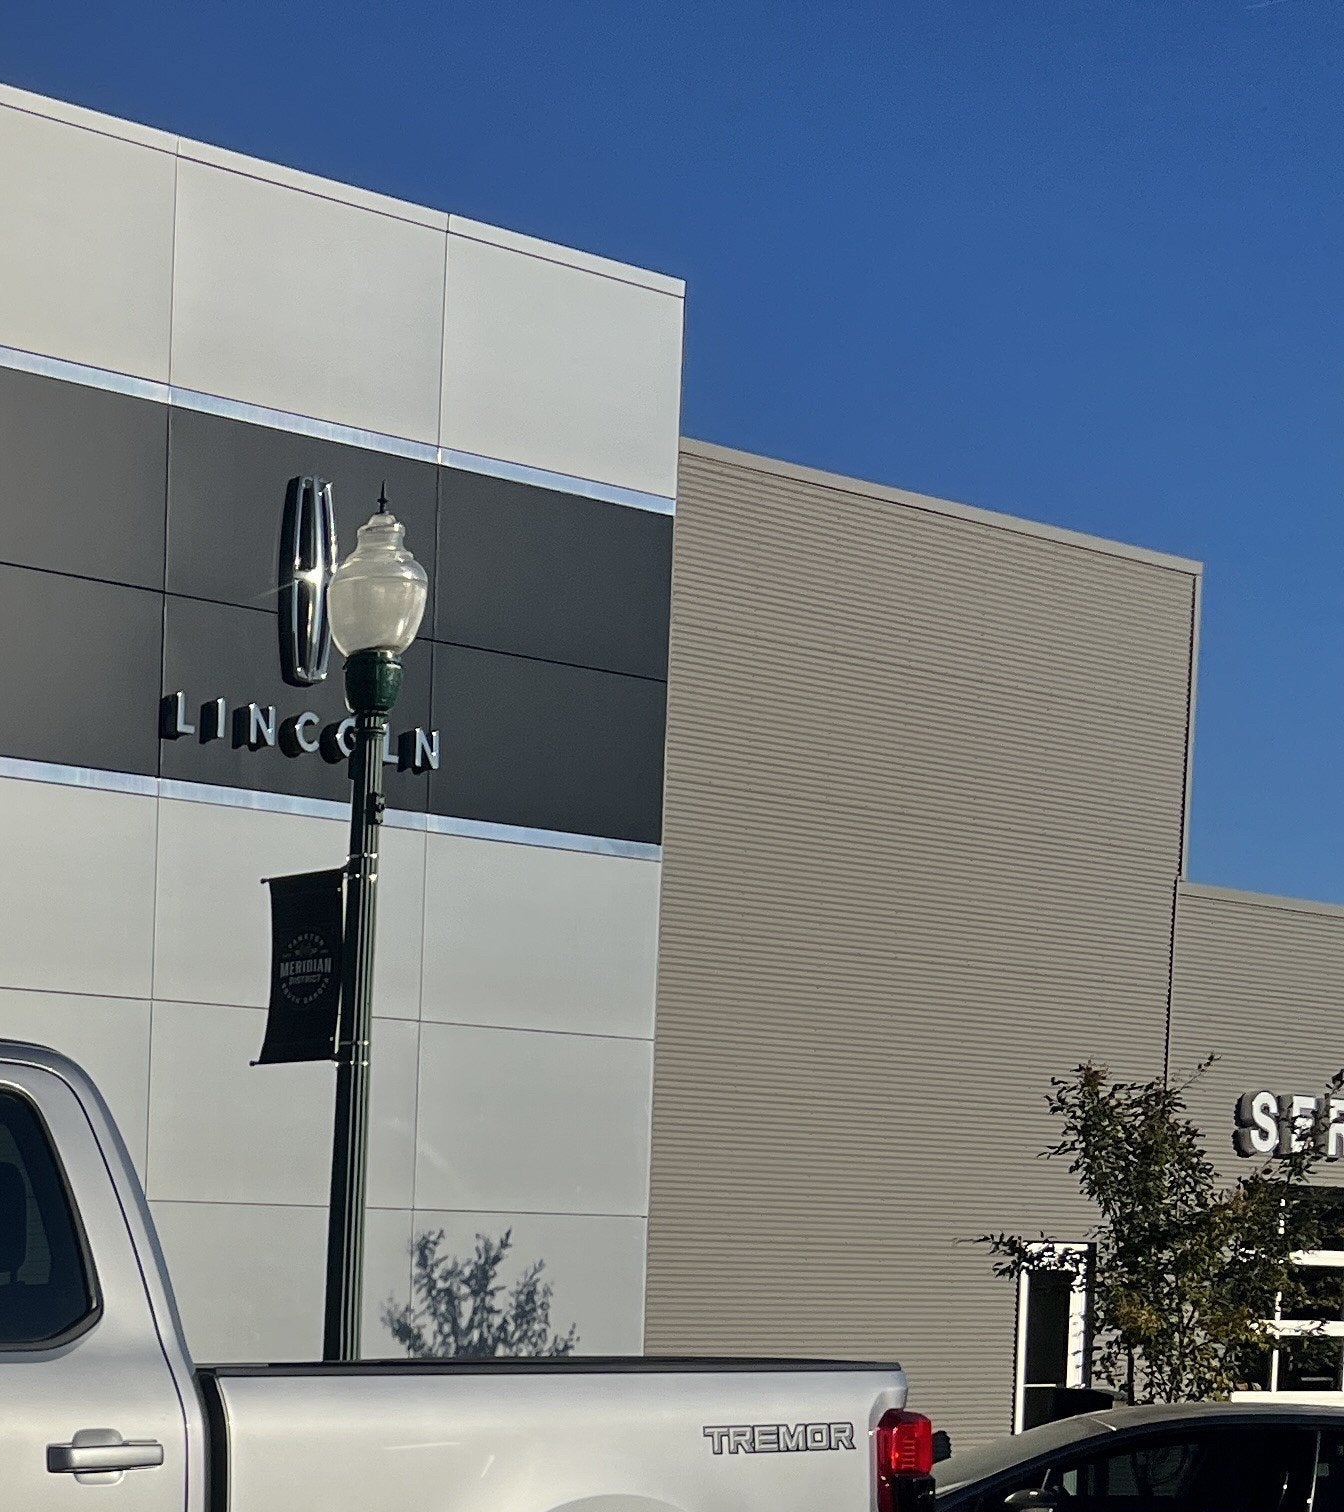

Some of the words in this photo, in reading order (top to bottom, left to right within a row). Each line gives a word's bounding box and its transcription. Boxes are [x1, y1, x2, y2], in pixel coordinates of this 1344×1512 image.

[175, 689, 441, 771] LINCOLN
[280, 957, 333, 979] MERIDIAN
[702, 1421, 857, 1455] TREMOR
